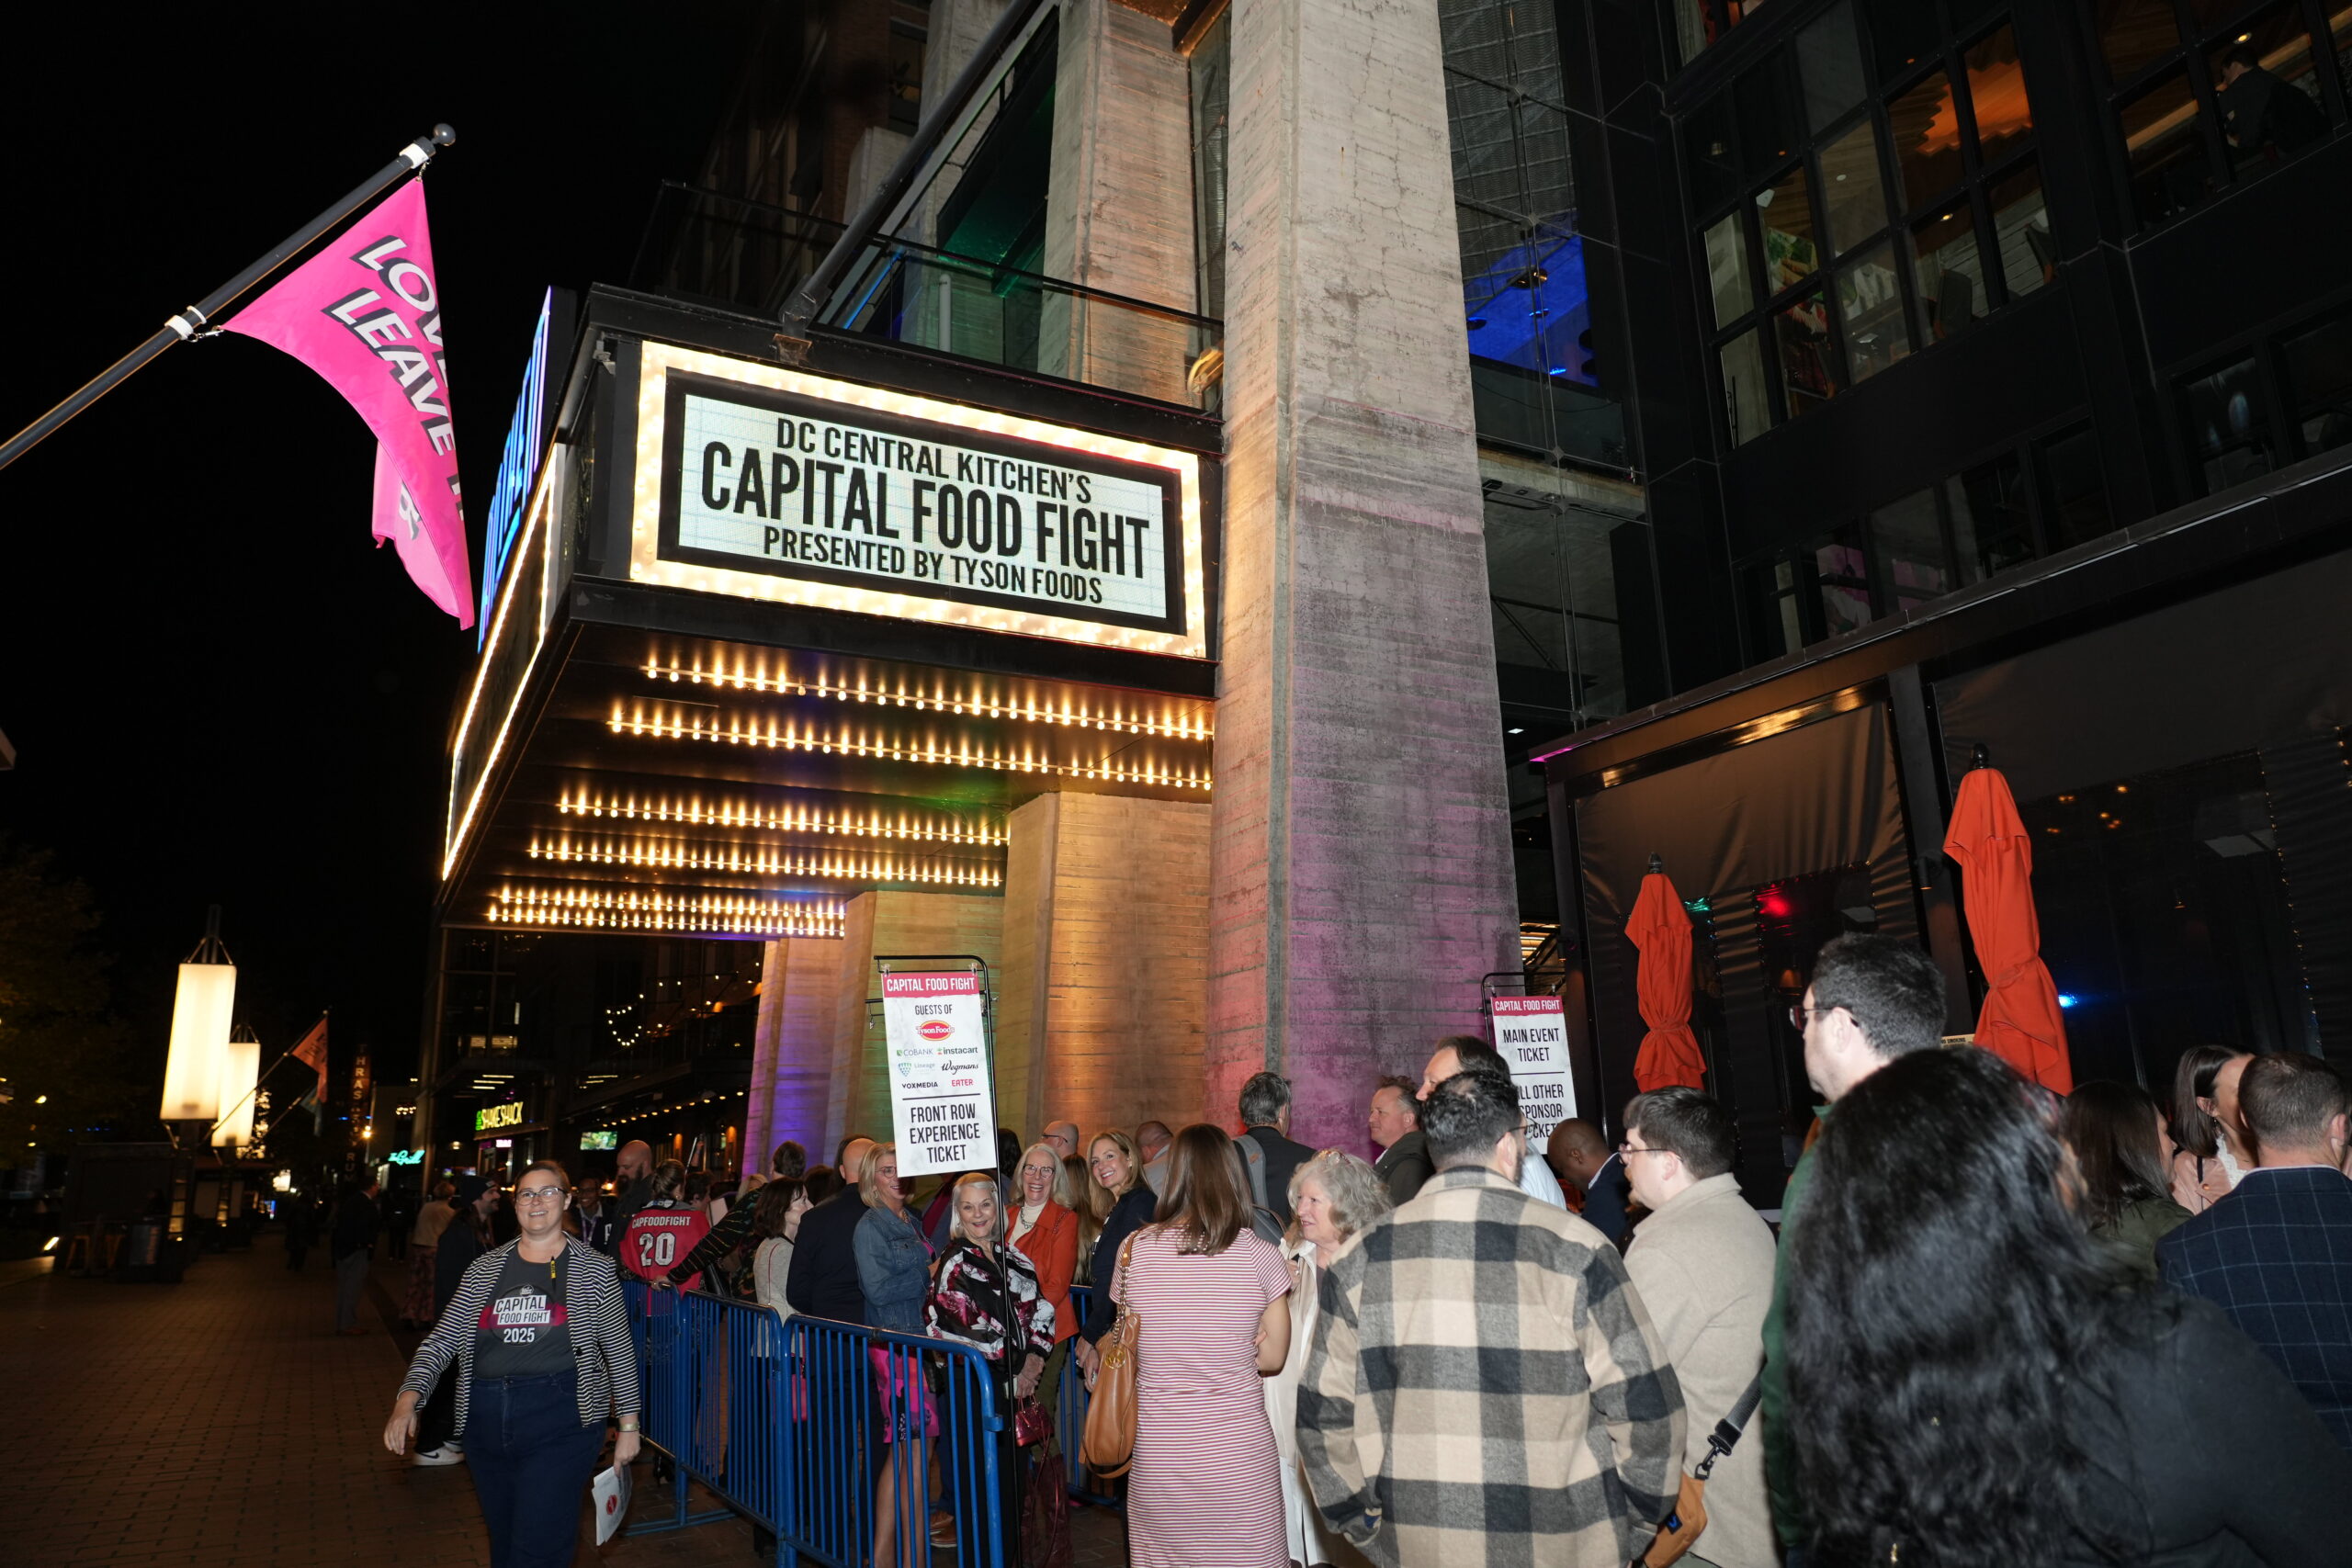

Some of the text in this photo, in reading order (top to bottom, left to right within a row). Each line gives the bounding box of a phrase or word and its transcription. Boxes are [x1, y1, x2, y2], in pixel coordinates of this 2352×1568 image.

[323, 288, 457, 456] LEAVE
[776, 418, 1091, 504] DC CENTRAL KITCHEN'S
[701, 441, 1149, 579] CAPITAL FOOD FIGHT
[763, 525, 1102, 604] PRESENTED BY TYSON FOODS
[887, 976, 976, 992] CAPITAL FOOD FIGHT
[914, 1003, 953, 1015] GUESTS OF
[1495, 999, 1560, 1011] CAPITAL FOOD FIGHT
[1503, 1028, 1559, 1043] MAIN EVENT
[943, 1046, 978, 1055] instacart
[1517, 1047, 1550, 1063] TICKET
[941, 1060, 978, 1076] Wegmans
[951, 1078, 974, 1088] EATER
[1517, 1084, 1565, 1100] LL OTHER
[481, 1101, 524, 1131] SHAKE SHACK
[910, 1103, 976, 1123] FRONT ROW
[910, 1122, 981, 1145] EXPERIENCE
[926, 1144, 967, 1164] TICKET
[632, 1215, 691, 1229] CAPFOODFIGHT
[639, 1232, 676, 1267] 20
[495, 1296, 545, 1314] CAPITAL
[499, 1311, 548, 1324] FOOD FIGHT
[503, 1327, 536, 1343] 2025
